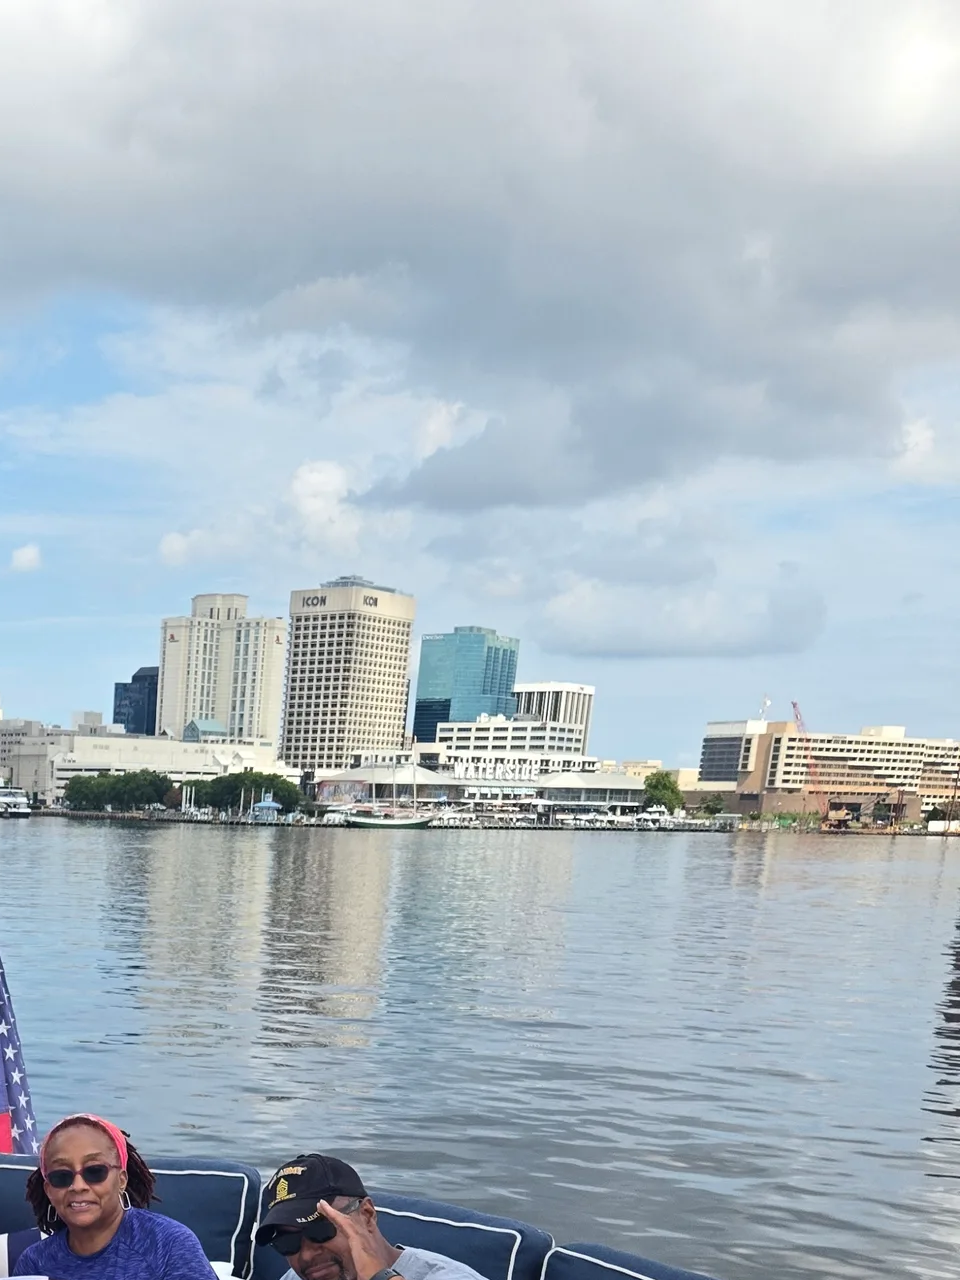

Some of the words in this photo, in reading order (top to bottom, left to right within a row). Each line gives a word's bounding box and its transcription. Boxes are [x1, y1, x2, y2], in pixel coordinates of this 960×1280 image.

[302, 595, 327, 608] ICON
[363, 595, 378, 607] ICON
[454, 762, 539, 781] WATERSIDE
